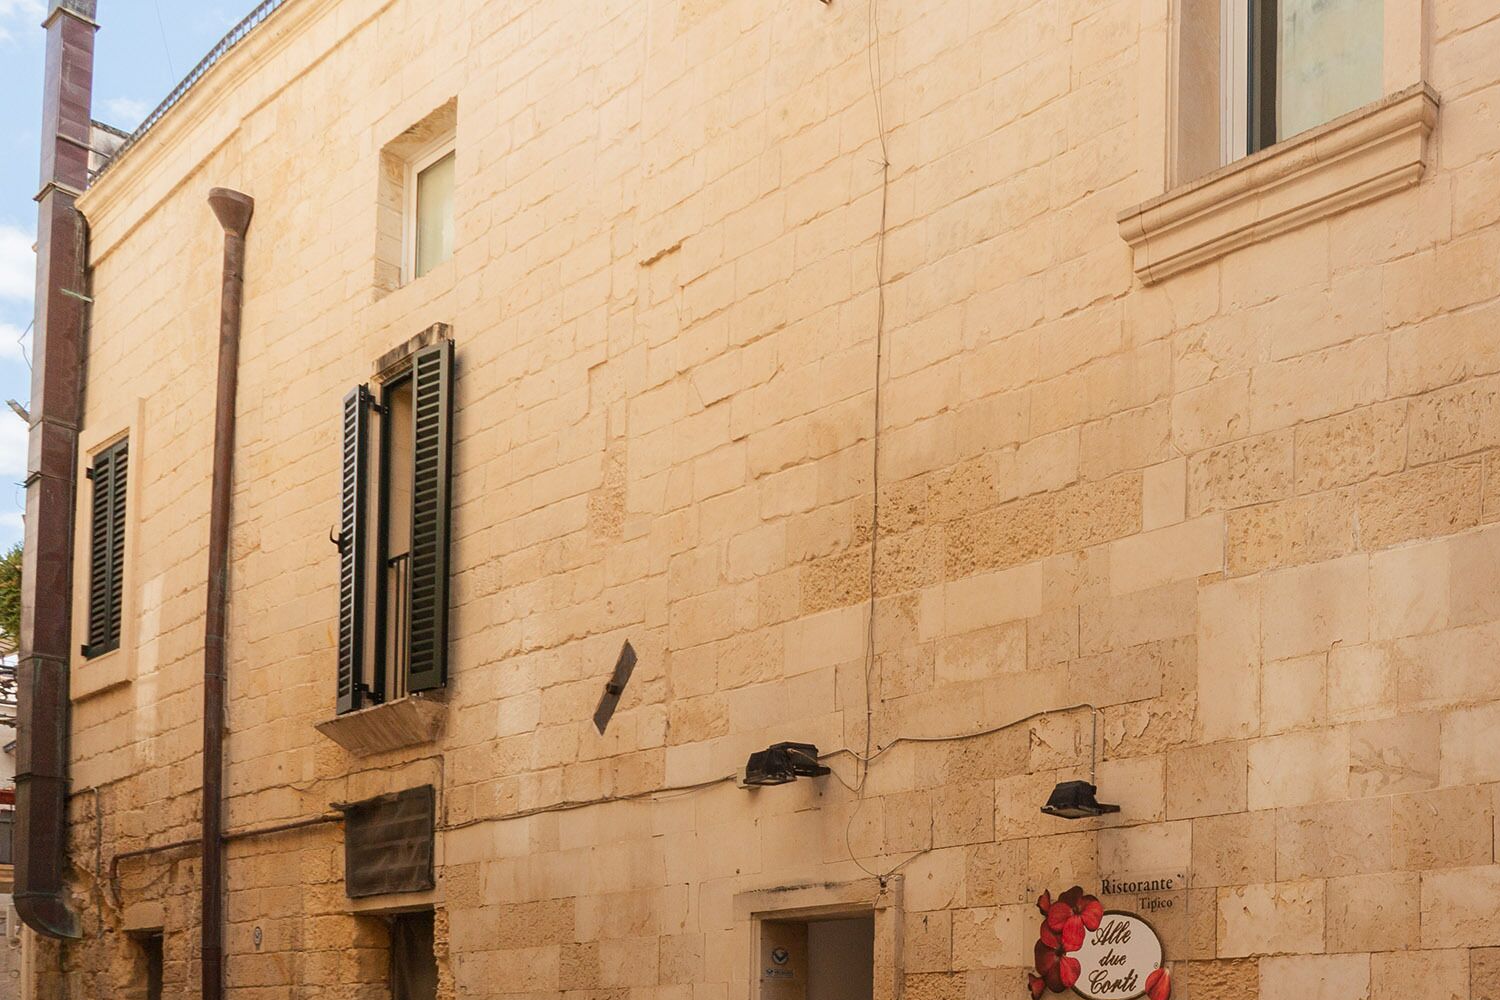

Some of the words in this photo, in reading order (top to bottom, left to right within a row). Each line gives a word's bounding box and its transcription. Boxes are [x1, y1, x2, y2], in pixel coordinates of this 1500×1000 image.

[1101, 878, 1173, 895] Ristorante
[1139, 896, 1173, 912] Tipico
[1091, 919, 1132, 946] Alle
[1098, 948, 1127, 967] due
[1088, 968, 1139, 995] Corti
